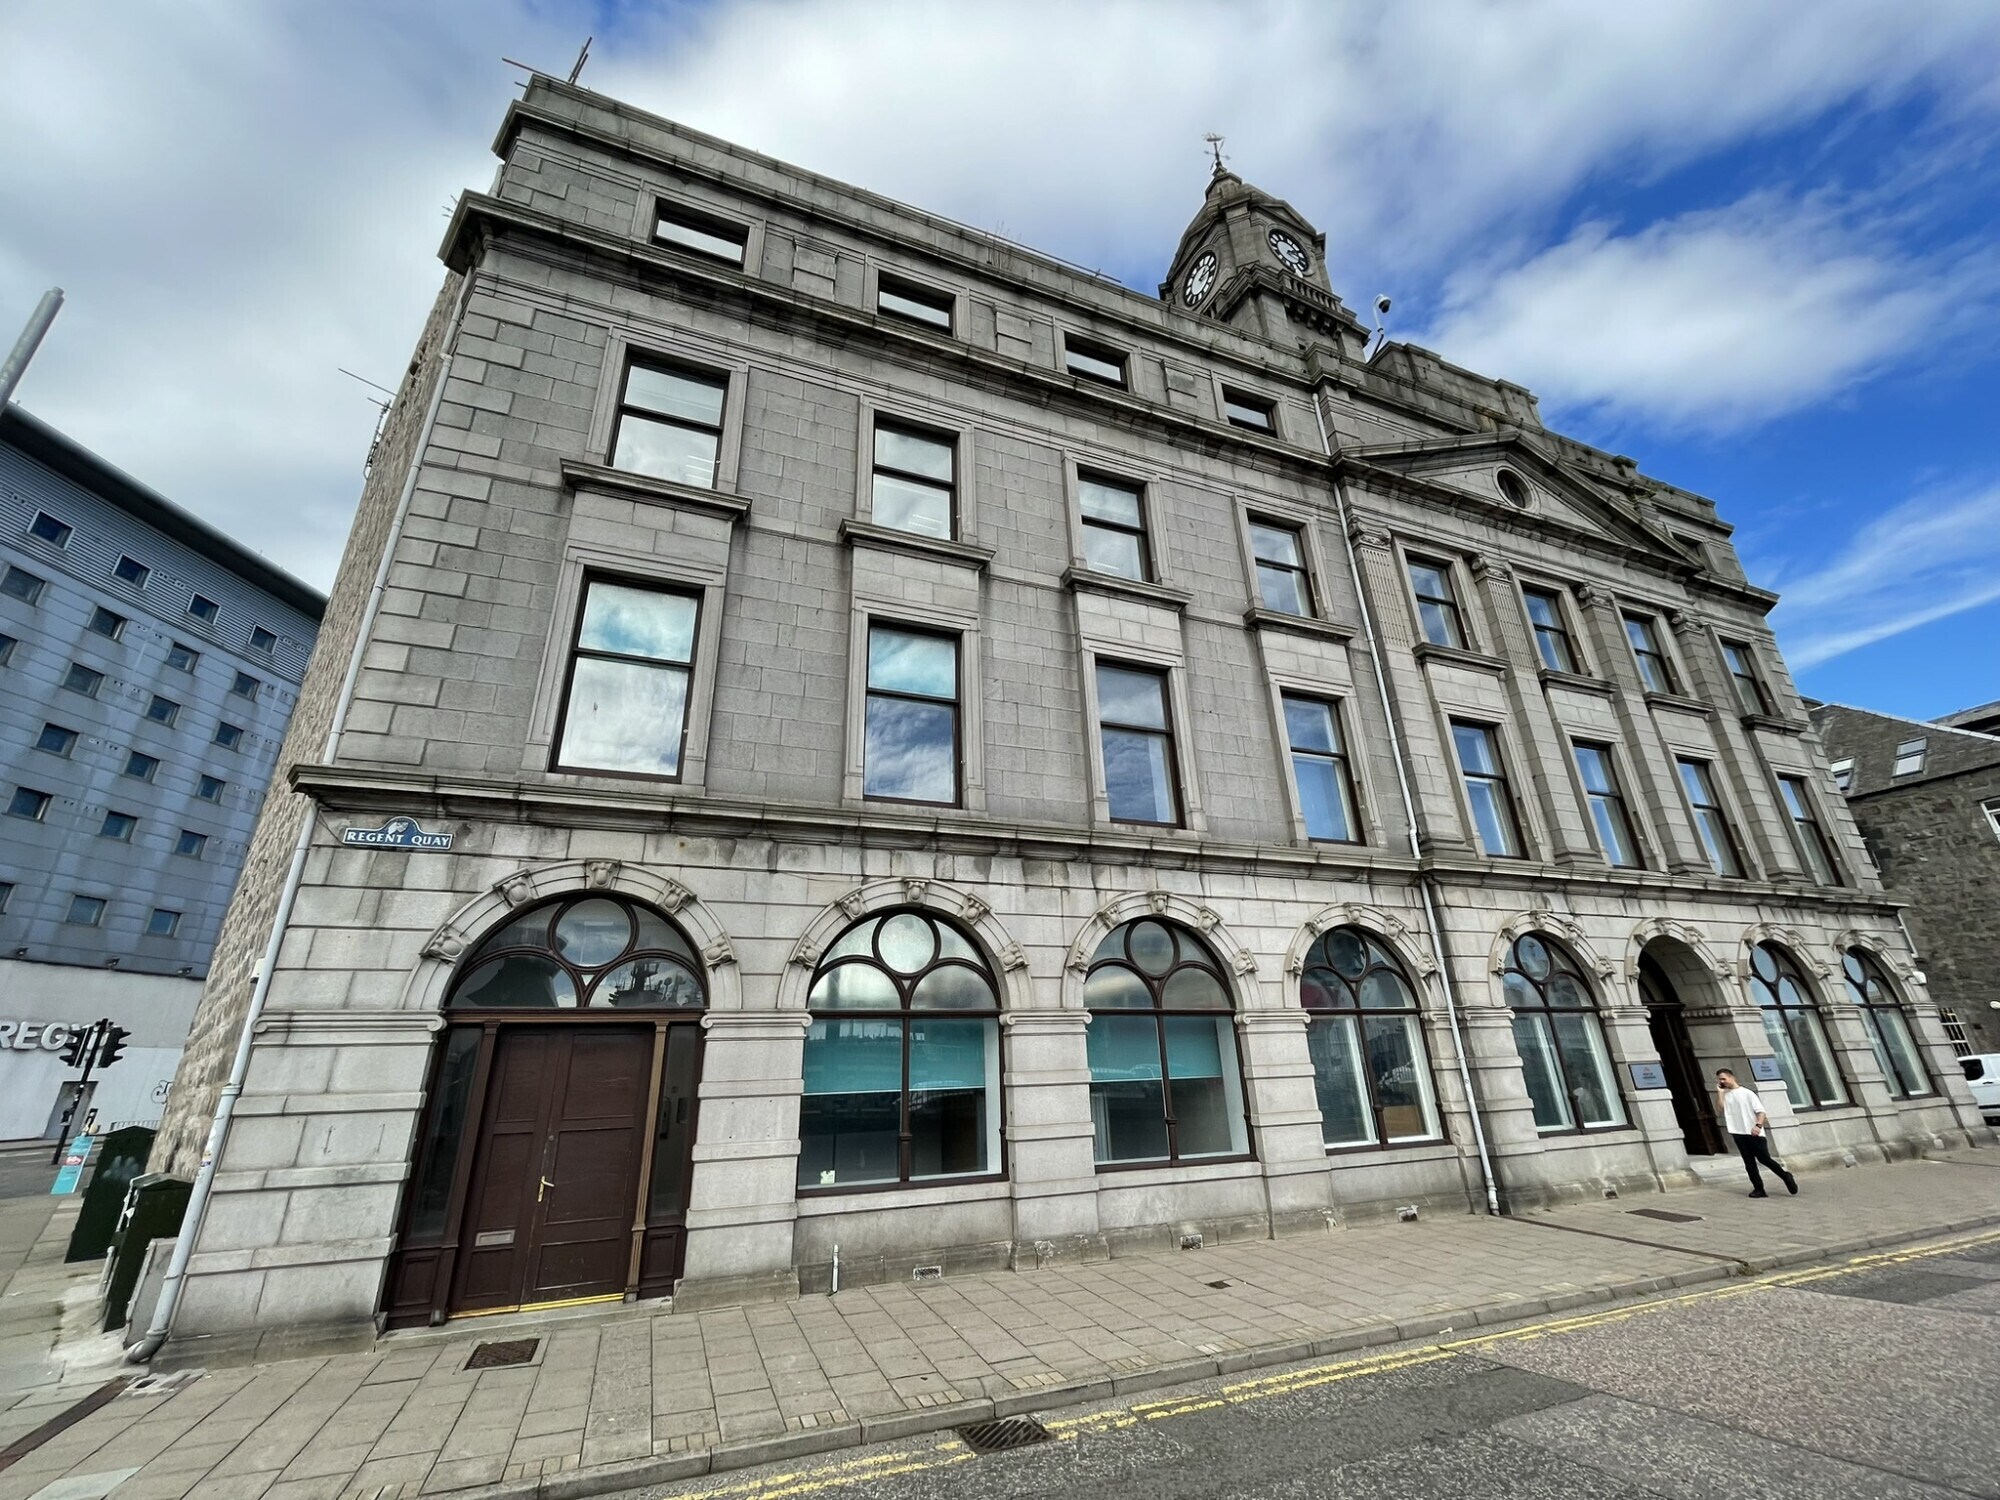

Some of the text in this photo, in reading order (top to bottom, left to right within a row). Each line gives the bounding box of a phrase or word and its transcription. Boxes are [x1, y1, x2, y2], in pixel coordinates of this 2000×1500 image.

[347, 831, 450, 846] REGENT QUAY
[0, 1021, 84, 1051] REG
